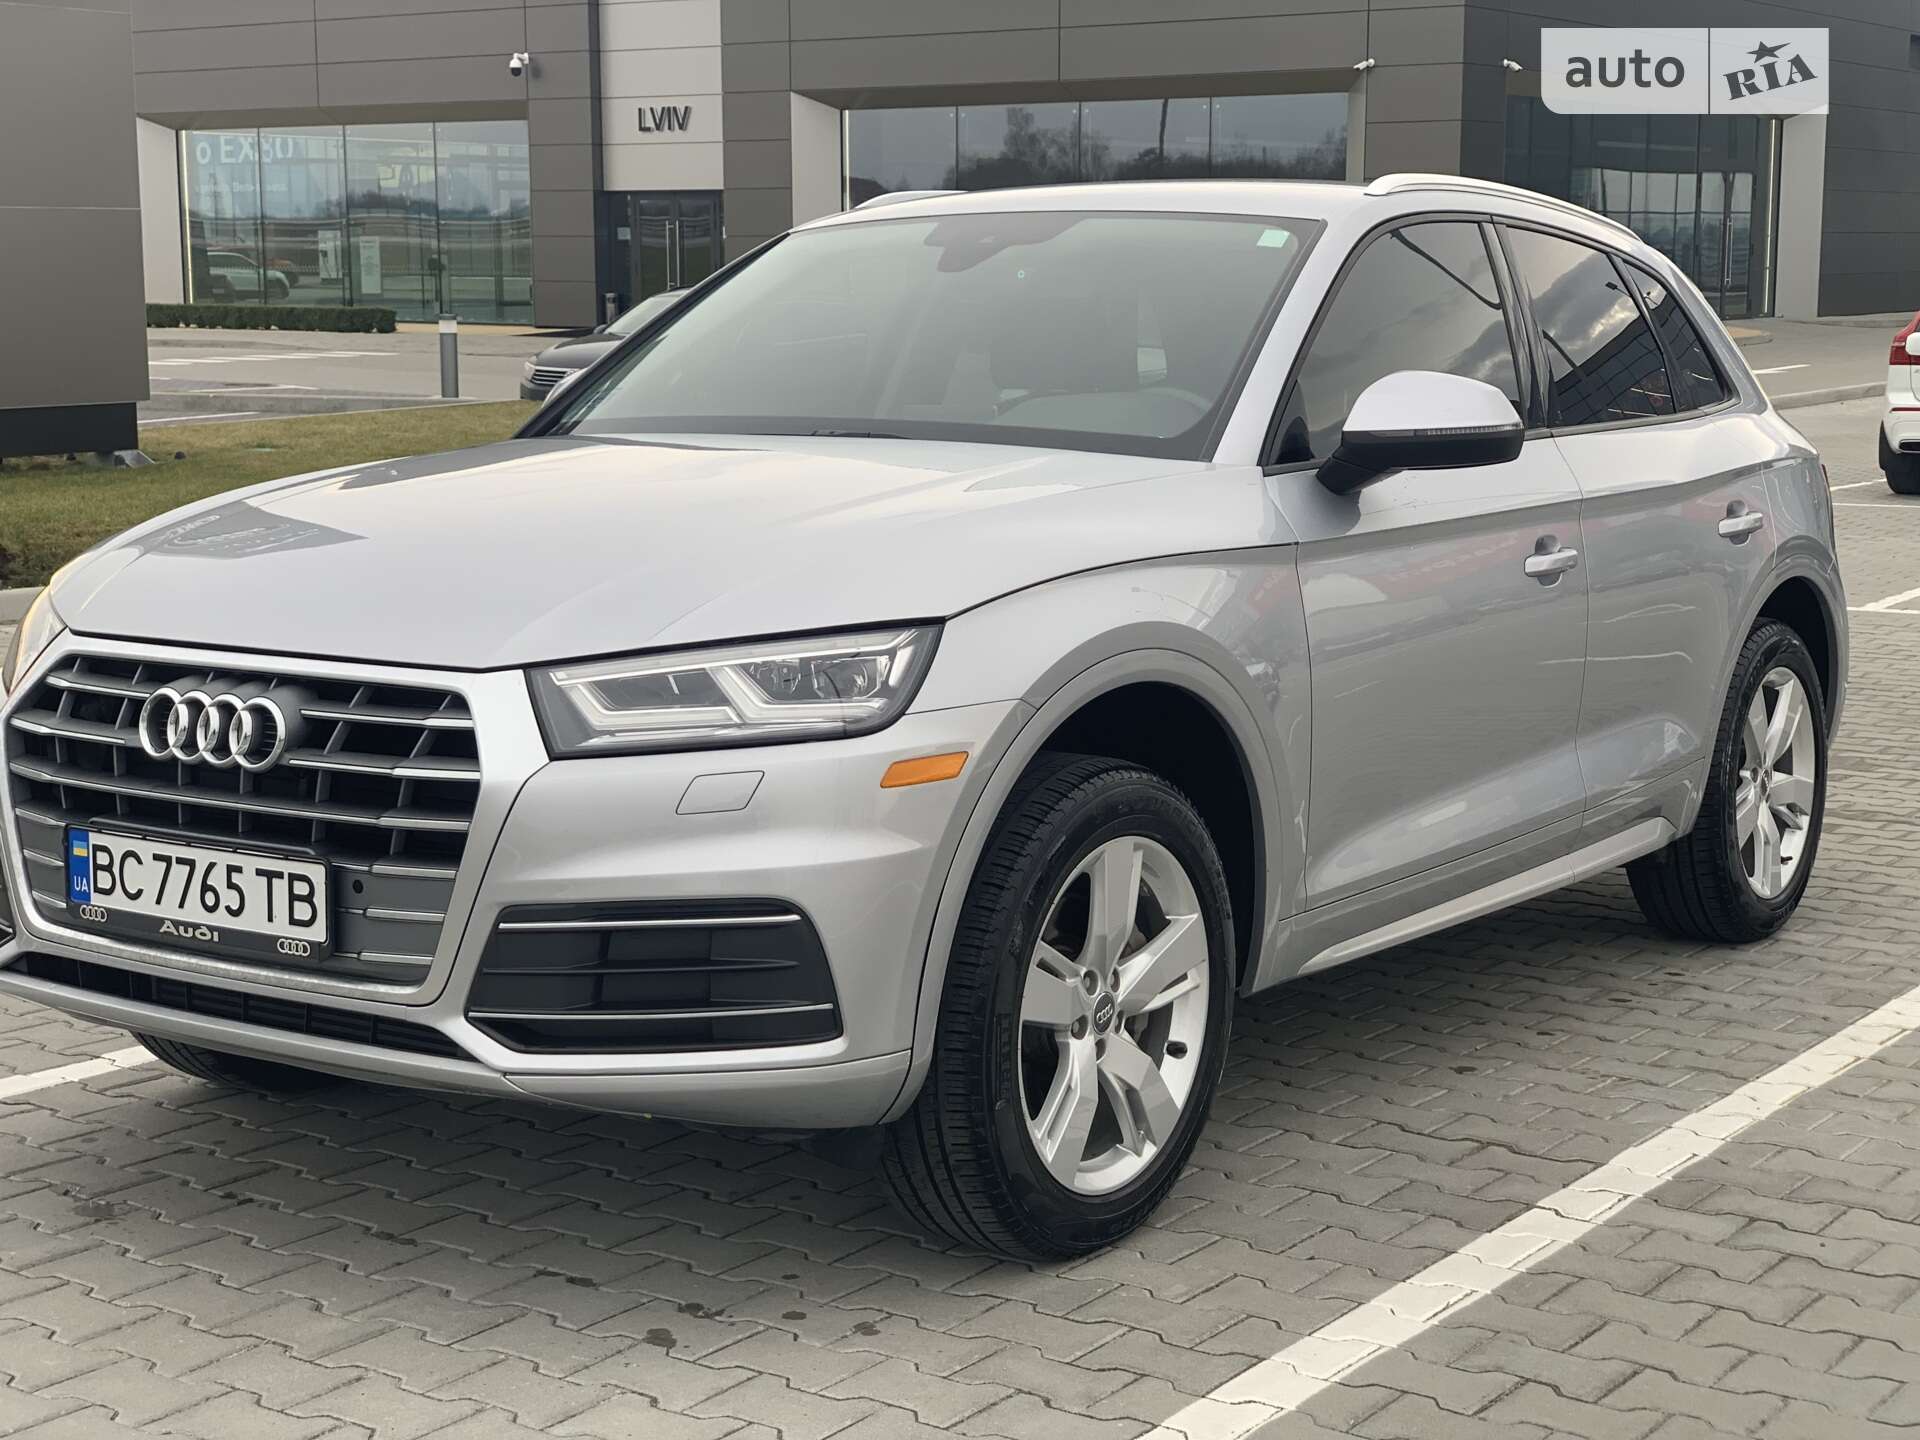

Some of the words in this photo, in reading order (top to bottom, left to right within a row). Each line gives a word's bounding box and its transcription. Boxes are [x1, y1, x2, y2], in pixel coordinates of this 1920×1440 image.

[638, 105, 692, 132] LVIV
[74, 875, 89, 893] UA
[92, 843, 145, 901] BC
[152, 852, 246, 918] 7765
[255, 867, 318, 928] TB
[159, 920, 220, 943] Audi
